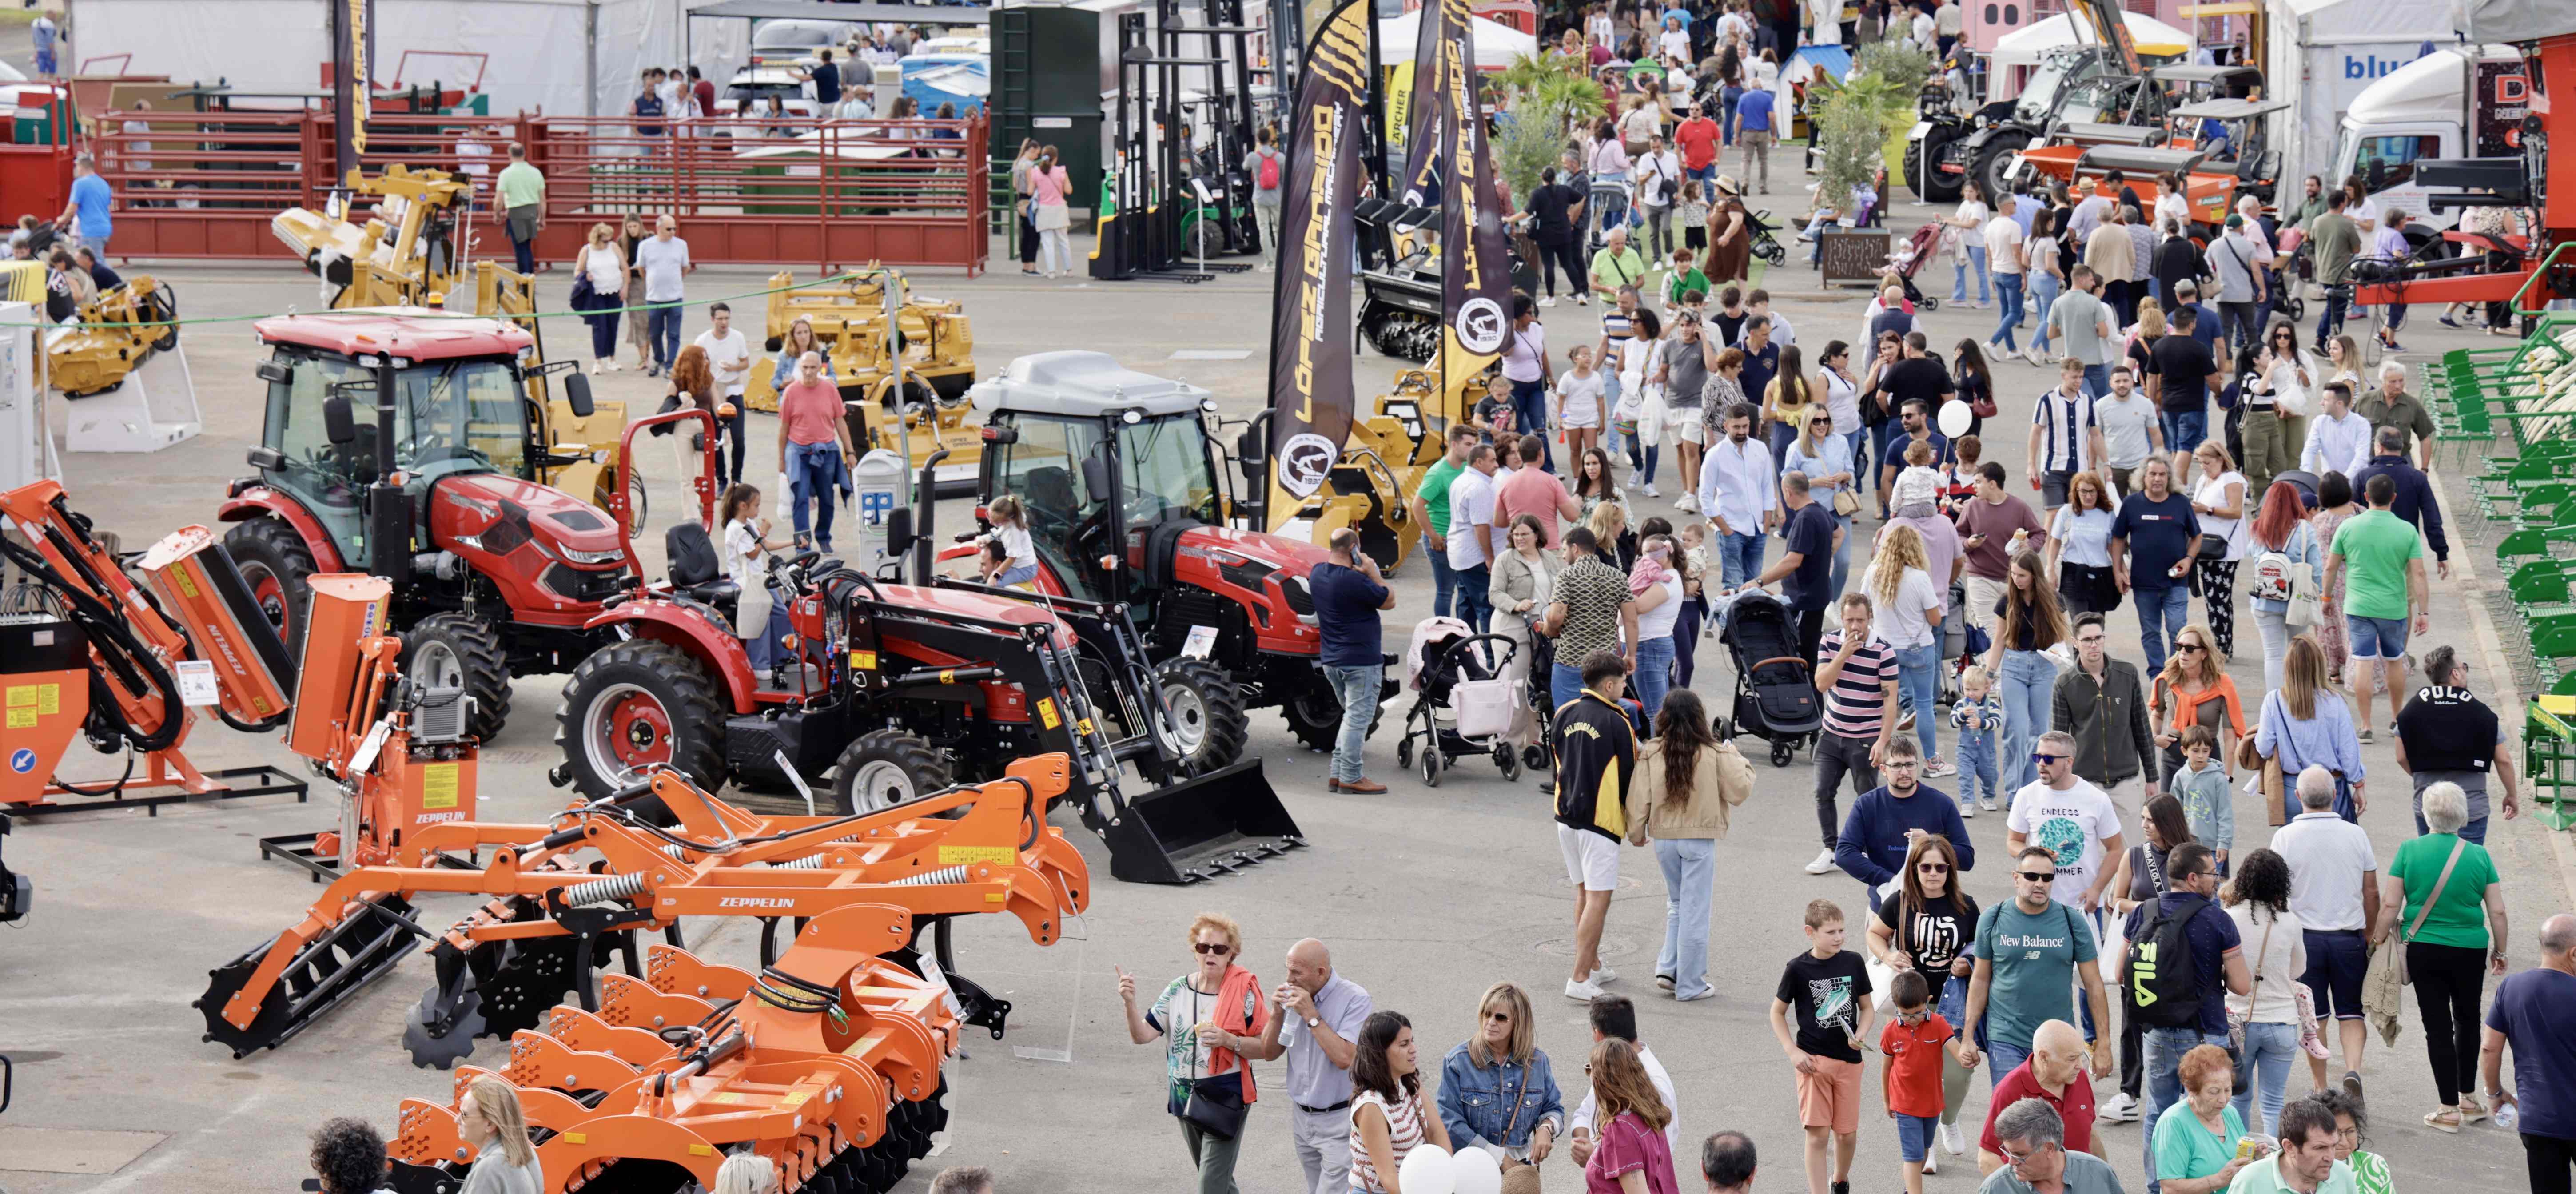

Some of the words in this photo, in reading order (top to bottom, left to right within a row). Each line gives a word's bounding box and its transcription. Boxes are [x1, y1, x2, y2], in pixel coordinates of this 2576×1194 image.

[2345, 55, 2414, 79] blu
[1303, 103, 1334, 278] GARRIDO
[1294, 280, 1318, 423] LÓPEZ
[206, 624, 247, 676] ZEPPELIN
[2419, 685, 2472, 702] POLO
[416, 811, 466, 824] ZEPPELIN
[2054, 867, 2083, 876] MMER
[719, 897, 795, 908] ZEPPELIN
[1999, 934, 2020, 947] New
[2133, 942, 2158, 1007] FILA
